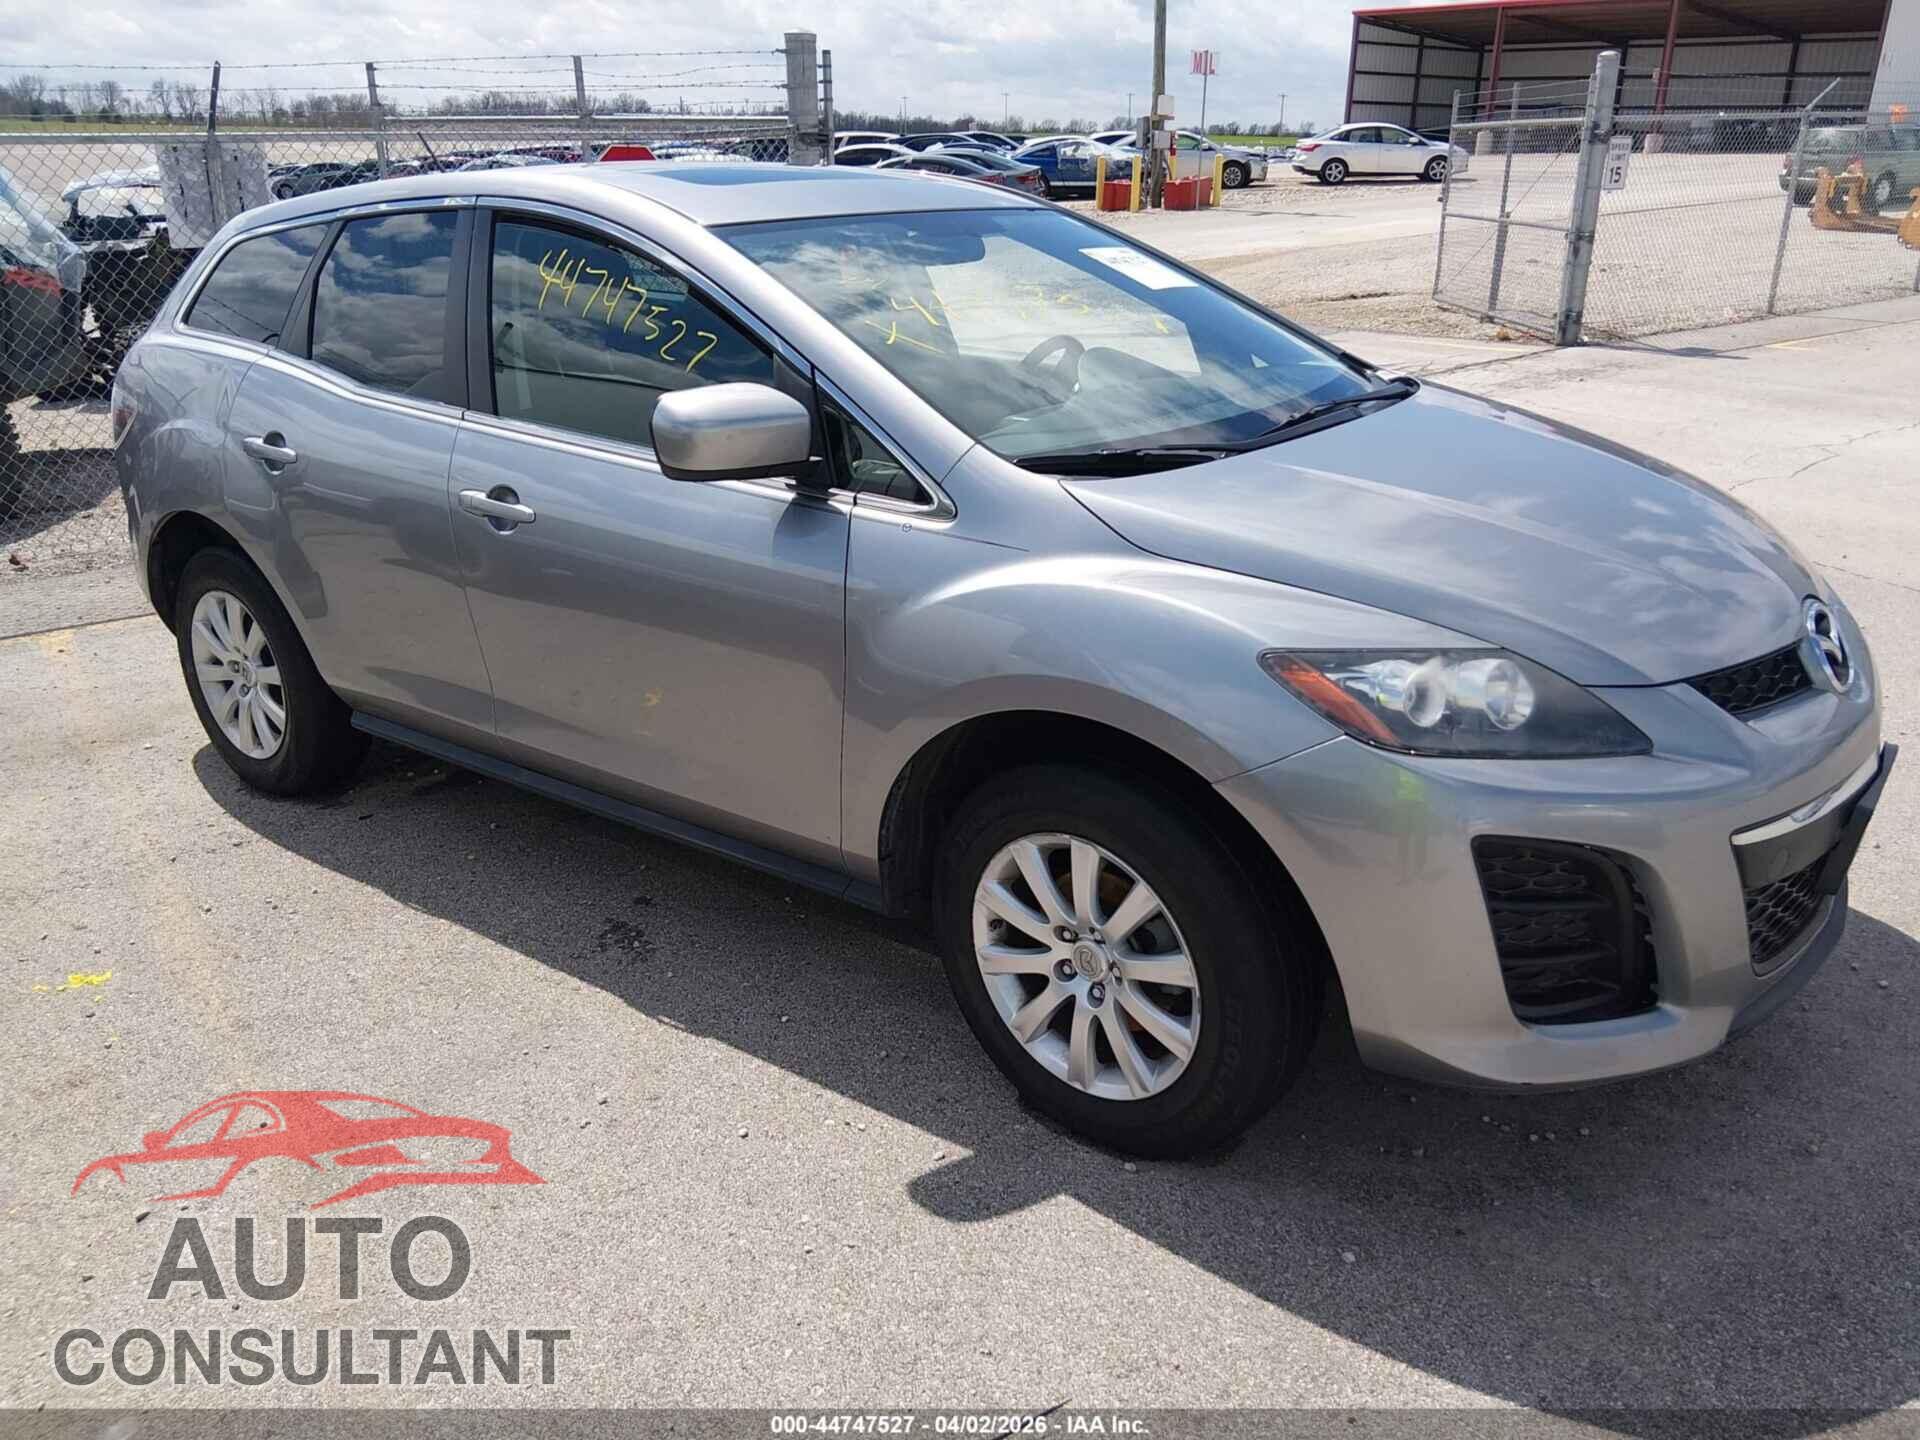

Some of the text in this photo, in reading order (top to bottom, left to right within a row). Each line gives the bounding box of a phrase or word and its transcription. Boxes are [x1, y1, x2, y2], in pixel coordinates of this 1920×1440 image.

[1611, 143, 1629, 151] SPEED
[1610, 153, 1626, 161] LIMIT
[1609, 166, 1623, 185] 15
[537, 248, 719, 375] 44747527
